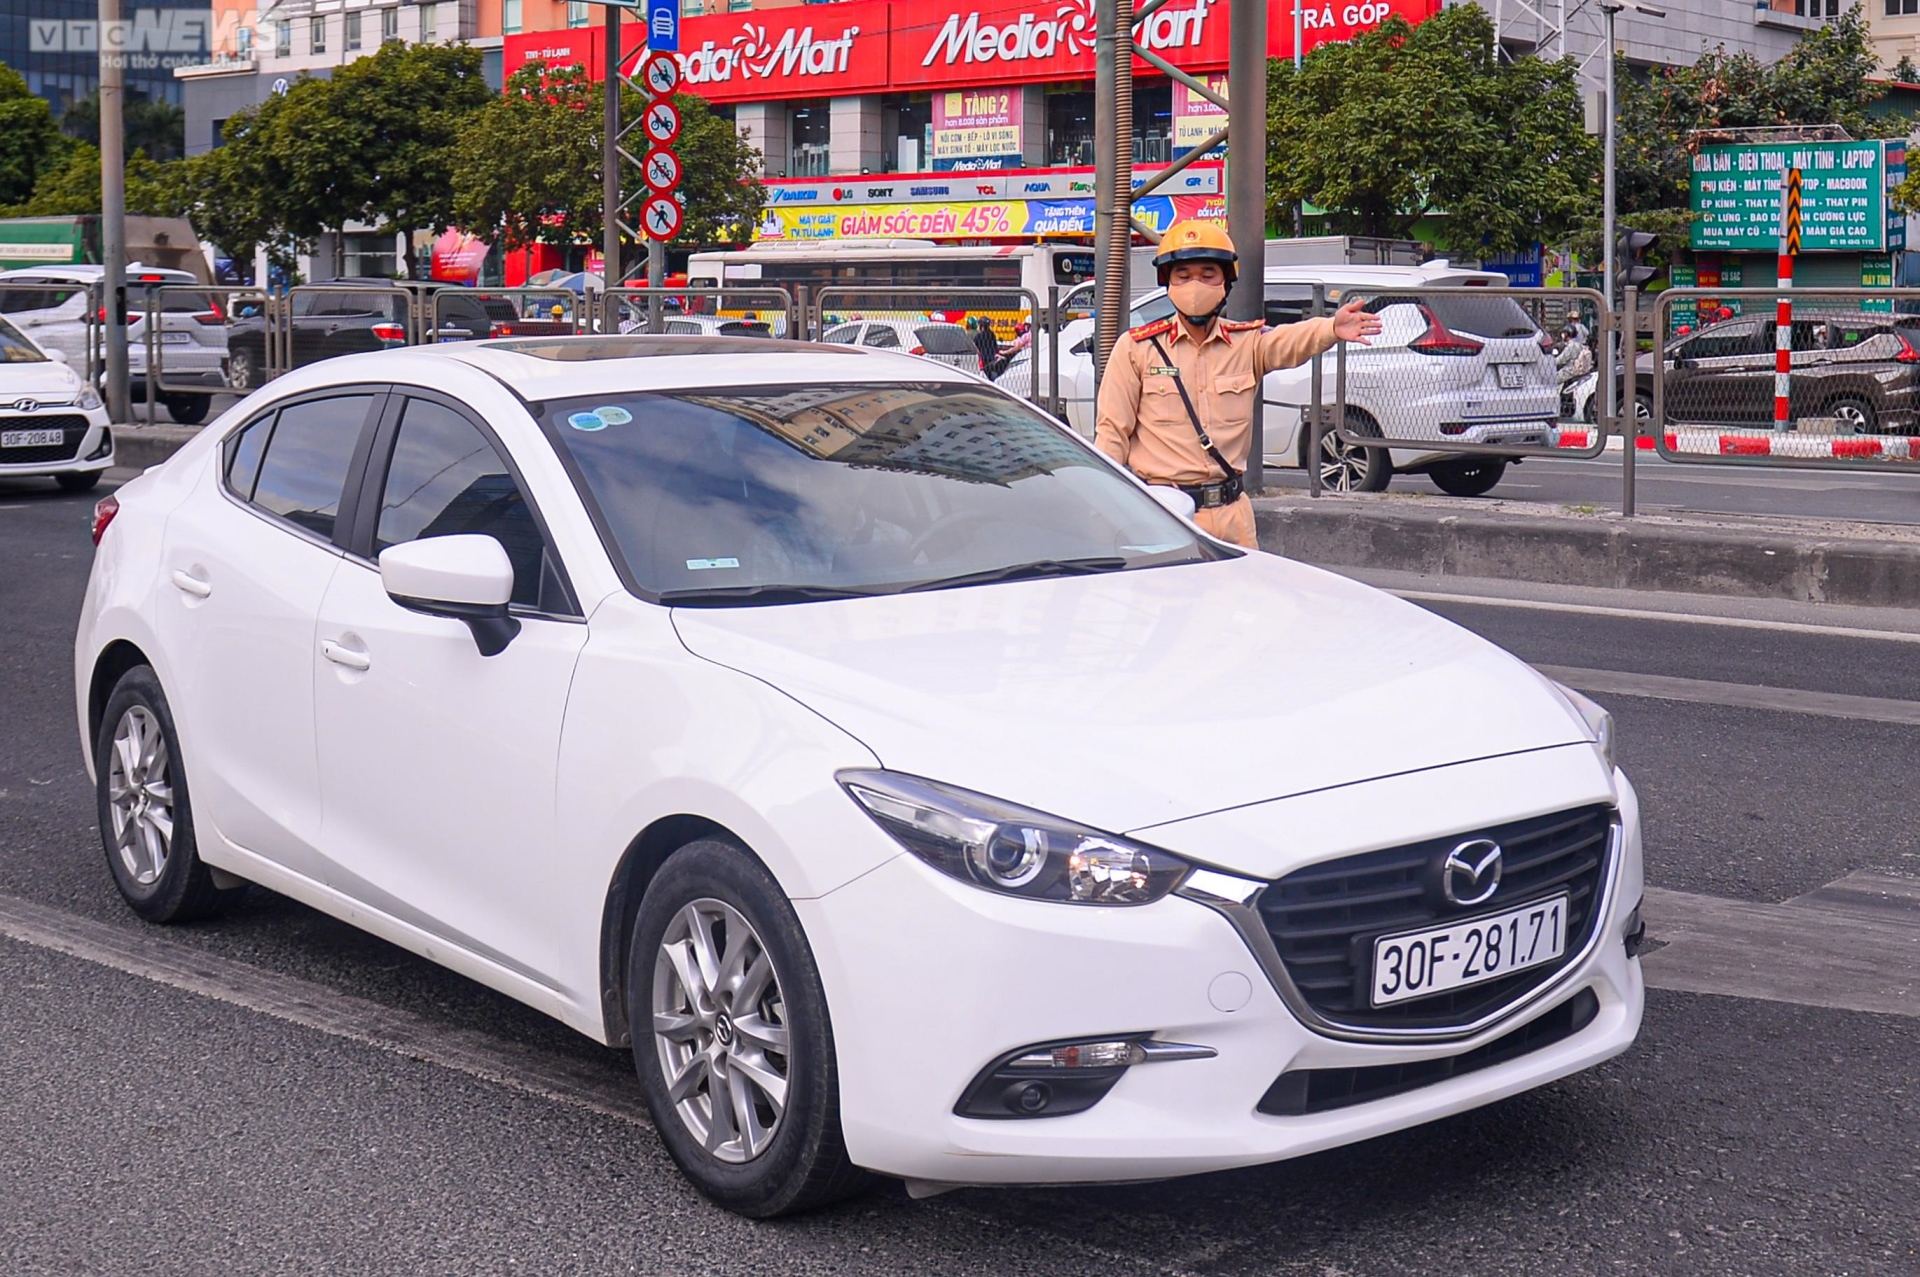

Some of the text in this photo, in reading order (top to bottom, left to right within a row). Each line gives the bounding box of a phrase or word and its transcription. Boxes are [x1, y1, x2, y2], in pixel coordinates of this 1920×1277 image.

[1342, 0, 1390, 26] GÓP
[921, 12, 1064, 66] Media
[1211, 75, 1229, 101] TẦ
[965, 91, 1009, 116] TẦNG 2
[1738, 148, 1759, 175] ĐIỆN
[1760, 151, 1785, 175] THOẠI
[1793, 146, 1812, 170] MÁY
[1814, 146, 1835, 170] TÍNH
[1842, 149, 1876, 169] LAPTOP
[867, 187, 894, 198] SONY
[910, 186, 950, 196] SAMSUNG
[976, 185, 997, 195] TCL
[1024, 182, 1051, 192] AQUA
[1718, 177, 1737, 194] KIỆN
[1743, 177, 1761, 192] MÁY
[1826, 177, 1868, 190] MACBOOK
[782, 189, 818, 201] DAIKIN
[842, 188, 853, 199] LG
[1714, 197, 1737, 209] KÍNH
[1744, 198, 1768, 208] THAY
[1825, 197, 1849, 207] THAY
[1851, 197, 1868, 207] PIN
[1044, 205, 1065, 218] TẶNG
[1750, 212, 1769, 222] BAO
[1813, 209, 1846, 222] CƯỜNG
[1847, 210, 1867, 224] LỰC
[841, 205, 1010, 236] GIẢM SỐC ĐẾN 45%
[1034, 217, 1058, 232] QUÀ
[1058, 216, 1085, 232] ĐẾN
[1703, 227, 1723, 237] MUA
[1725, 225, 1745, 237] MÁY
[1747, 225, 1760, 237] CŨ
[1806, 224, 1827, 236] MÀN
[1829, 224, 1846, 236] GIÁ
[1847, 226, 1868, 236] CAO
[1381, 904, 1560, 996] 30F-281.71
